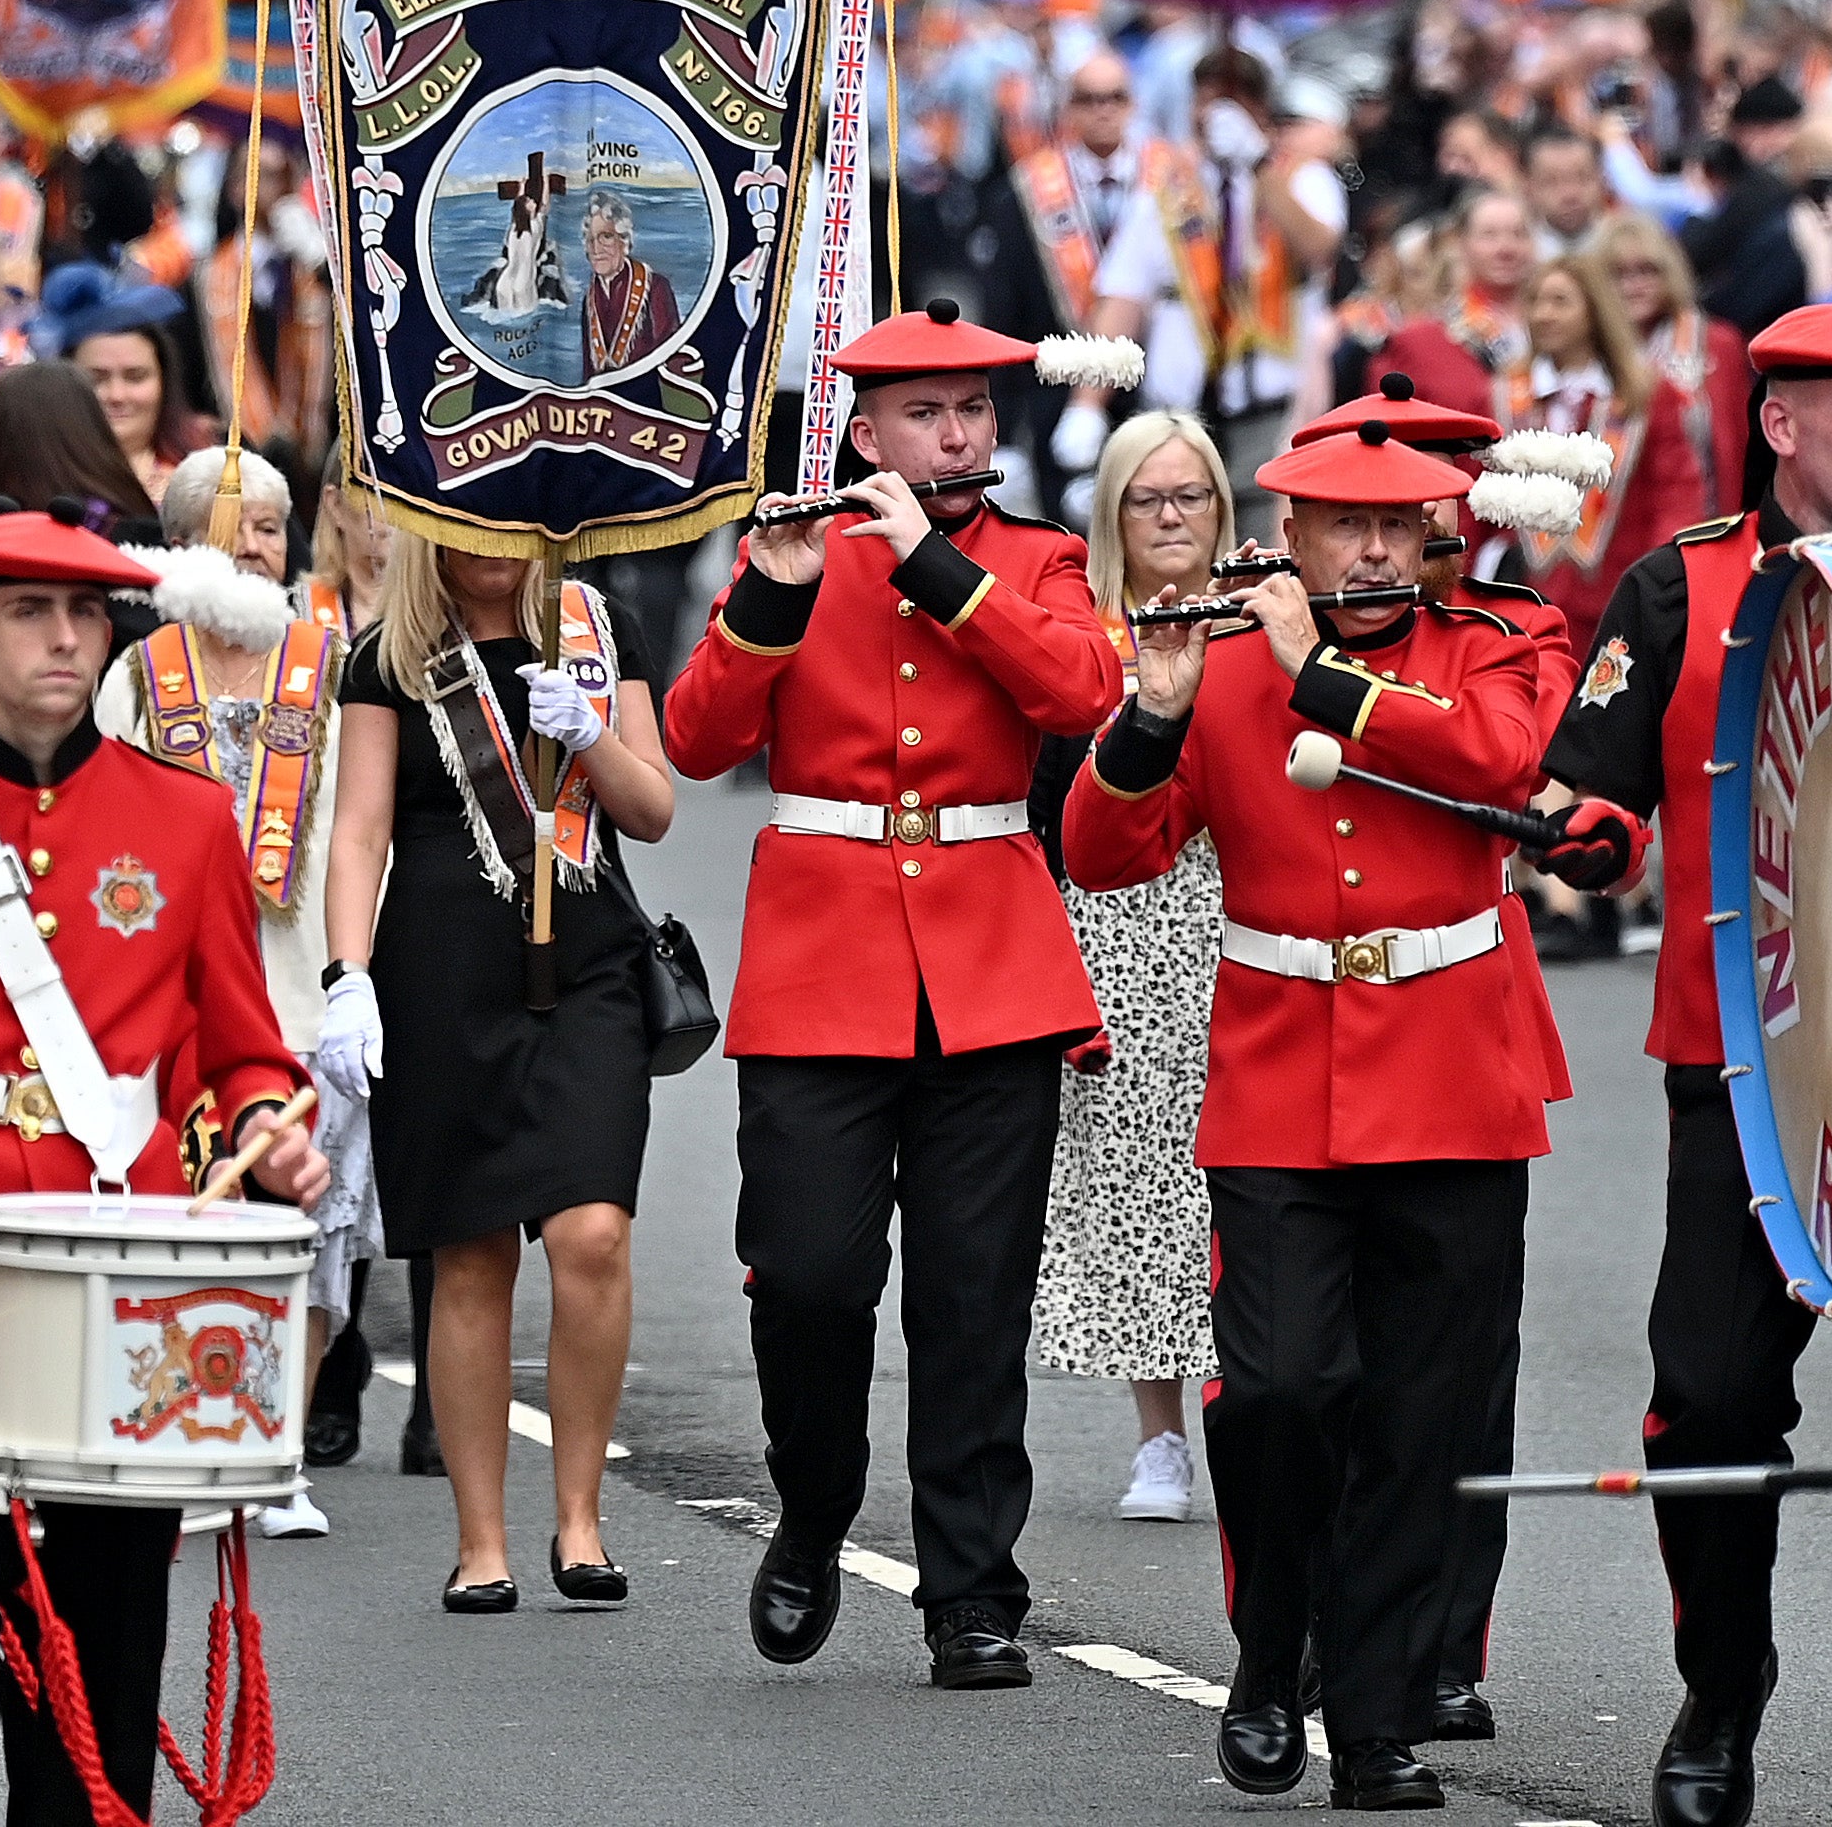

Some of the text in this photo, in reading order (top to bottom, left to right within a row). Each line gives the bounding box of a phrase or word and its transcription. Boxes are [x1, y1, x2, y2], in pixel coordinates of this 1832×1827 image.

[366, 57, 473, 140] L.L.O.L.
[446, 404, 687, 468] GOVAN DIST. 42
[568, 663, 606, 683] 166
